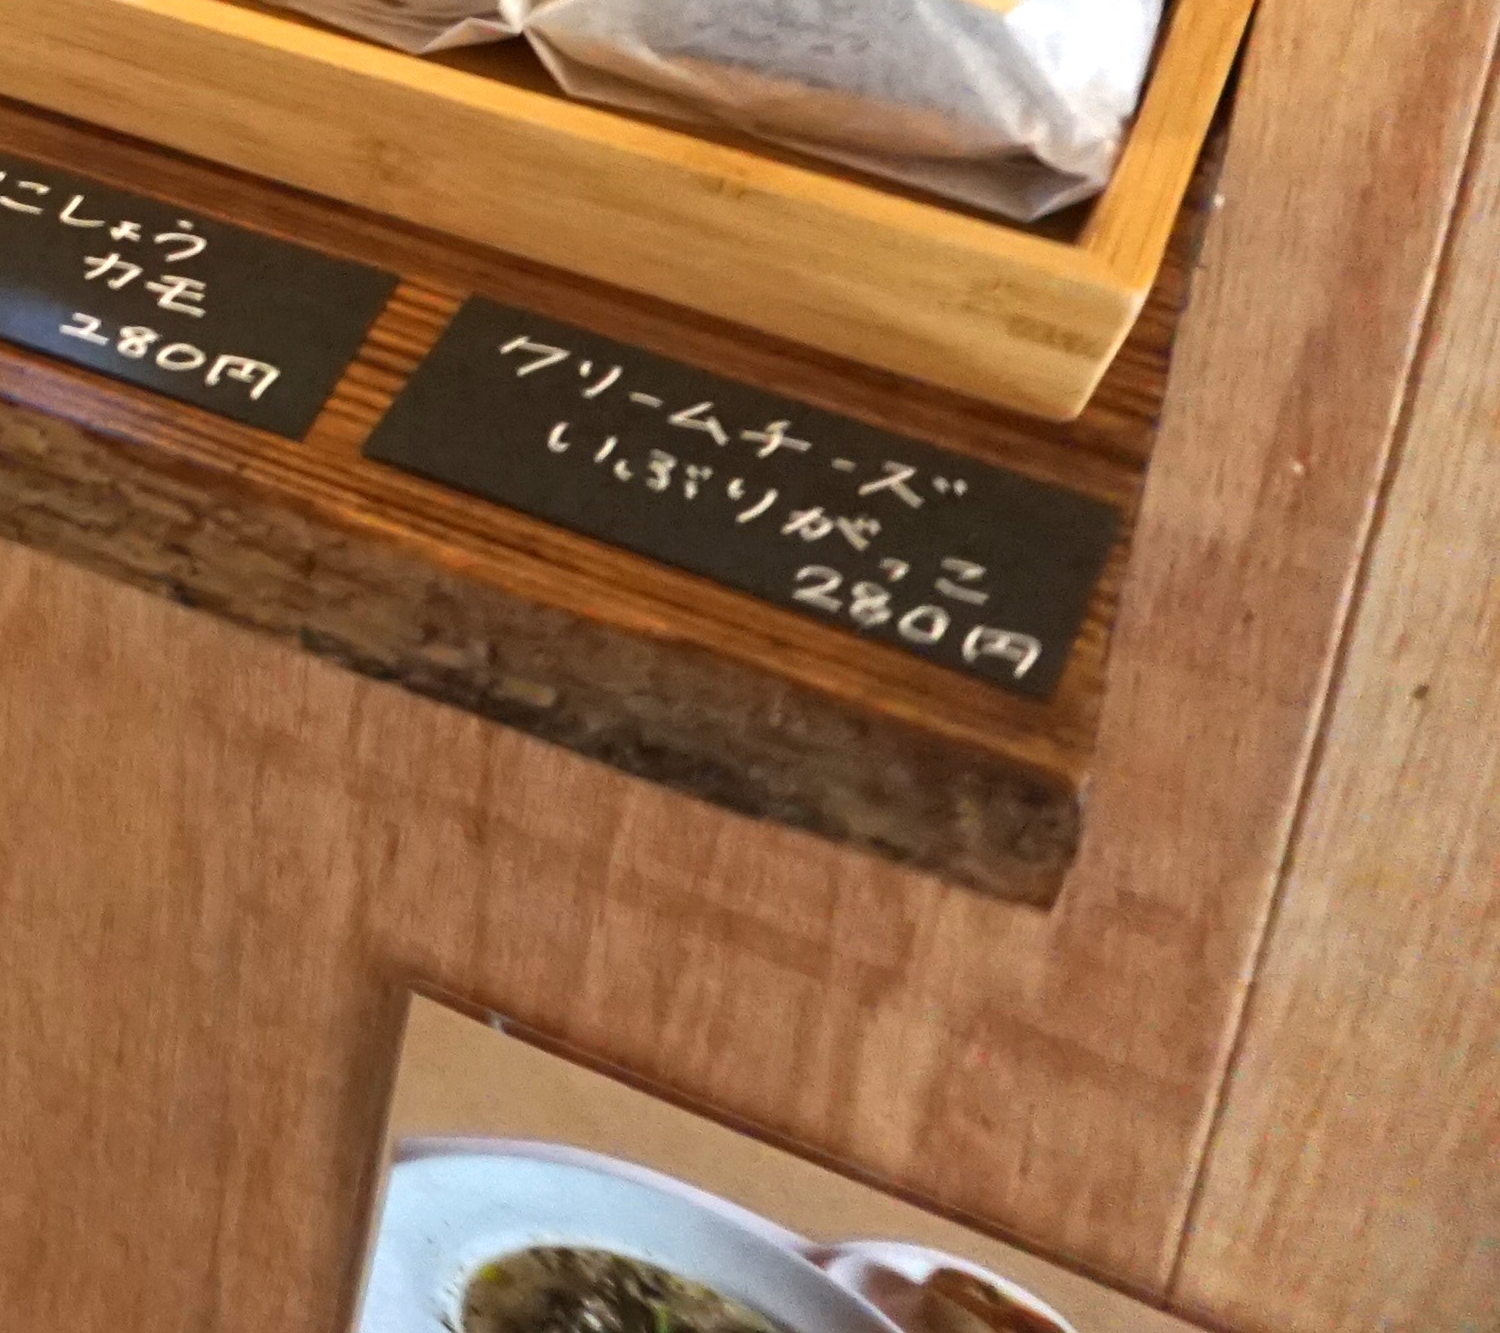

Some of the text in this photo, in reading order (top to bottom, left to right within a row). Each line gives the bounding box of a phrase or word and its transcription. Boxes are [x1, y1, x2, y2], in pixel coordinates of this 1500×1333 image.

[83, 251, 209, 319] カモ
[58, 311, 282, 401] 280円
[500, 334, 968, 508] クリームチーズ
[793, 564, 1042, 680] 280円
